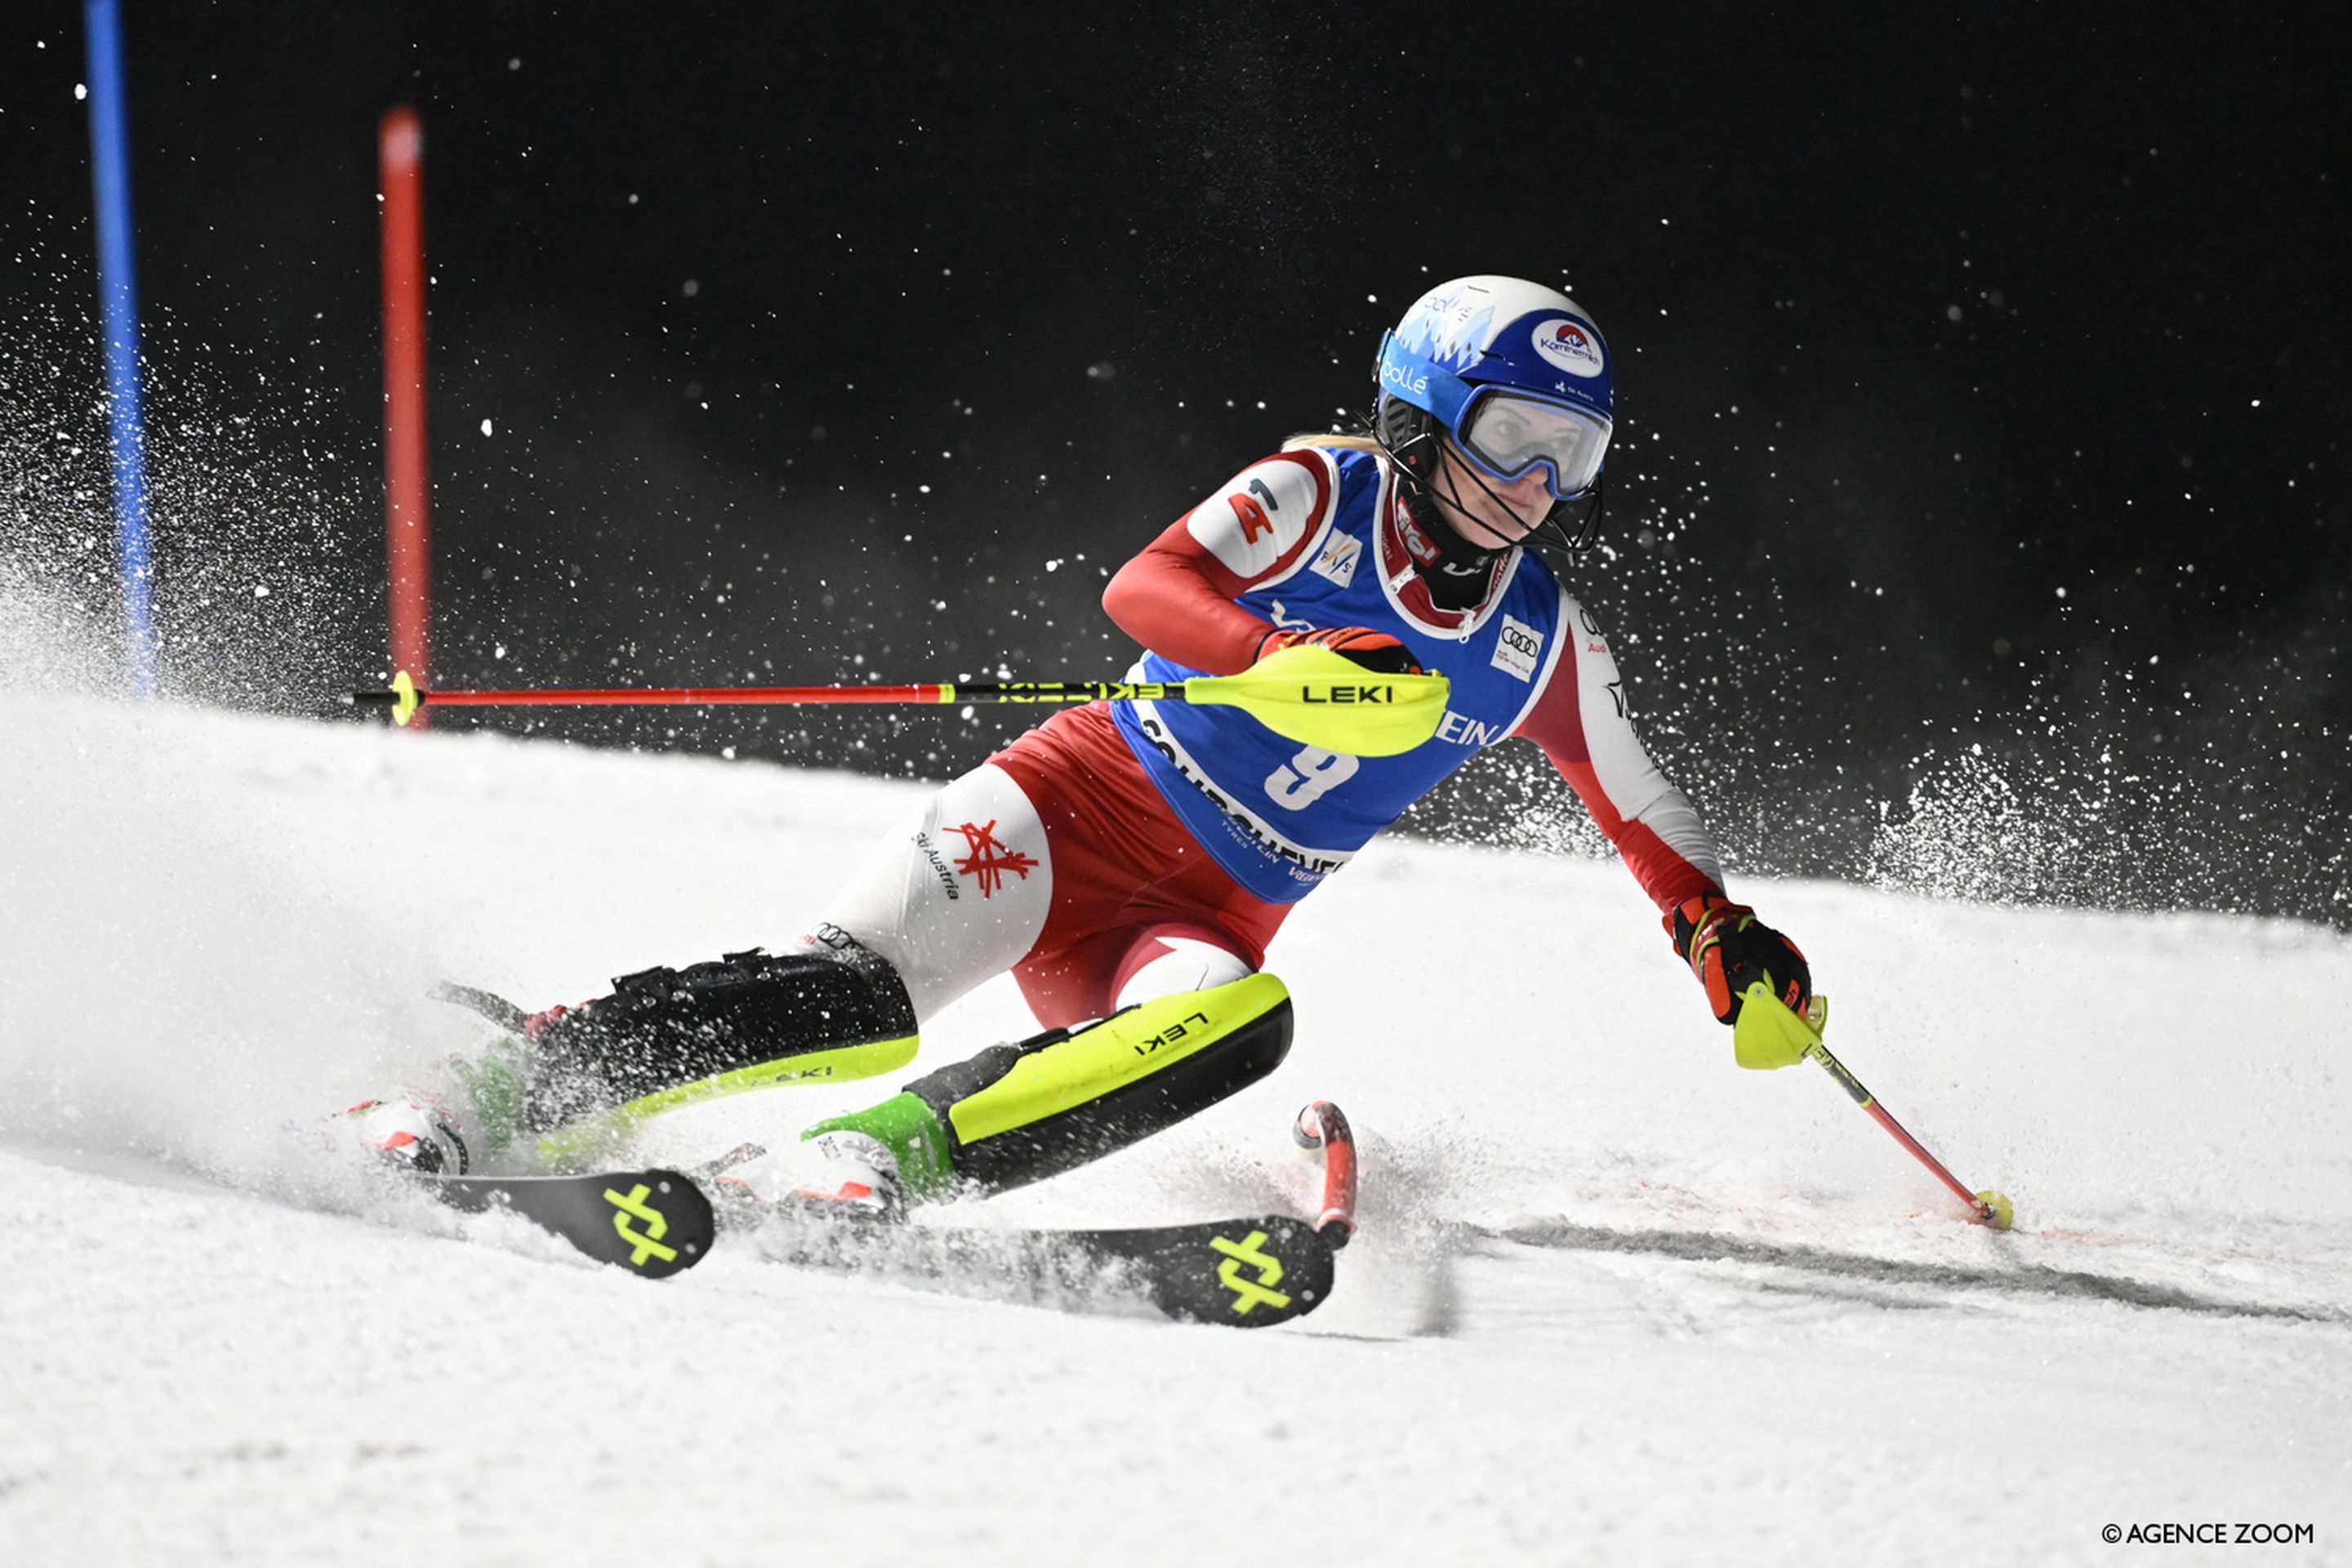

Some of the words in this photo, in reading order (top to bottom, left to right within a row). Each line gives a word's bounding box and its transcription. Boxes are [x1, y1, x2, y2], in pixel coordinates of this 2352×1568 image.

[1227, 478, 1278, 545] A1
[1303, 686, 1392, 703] LEKI
[1263, 743, 1360, 811] 9
[923, 850, 960, 900] Austria
[1134, 1012, 1209, 1056] LEKI
